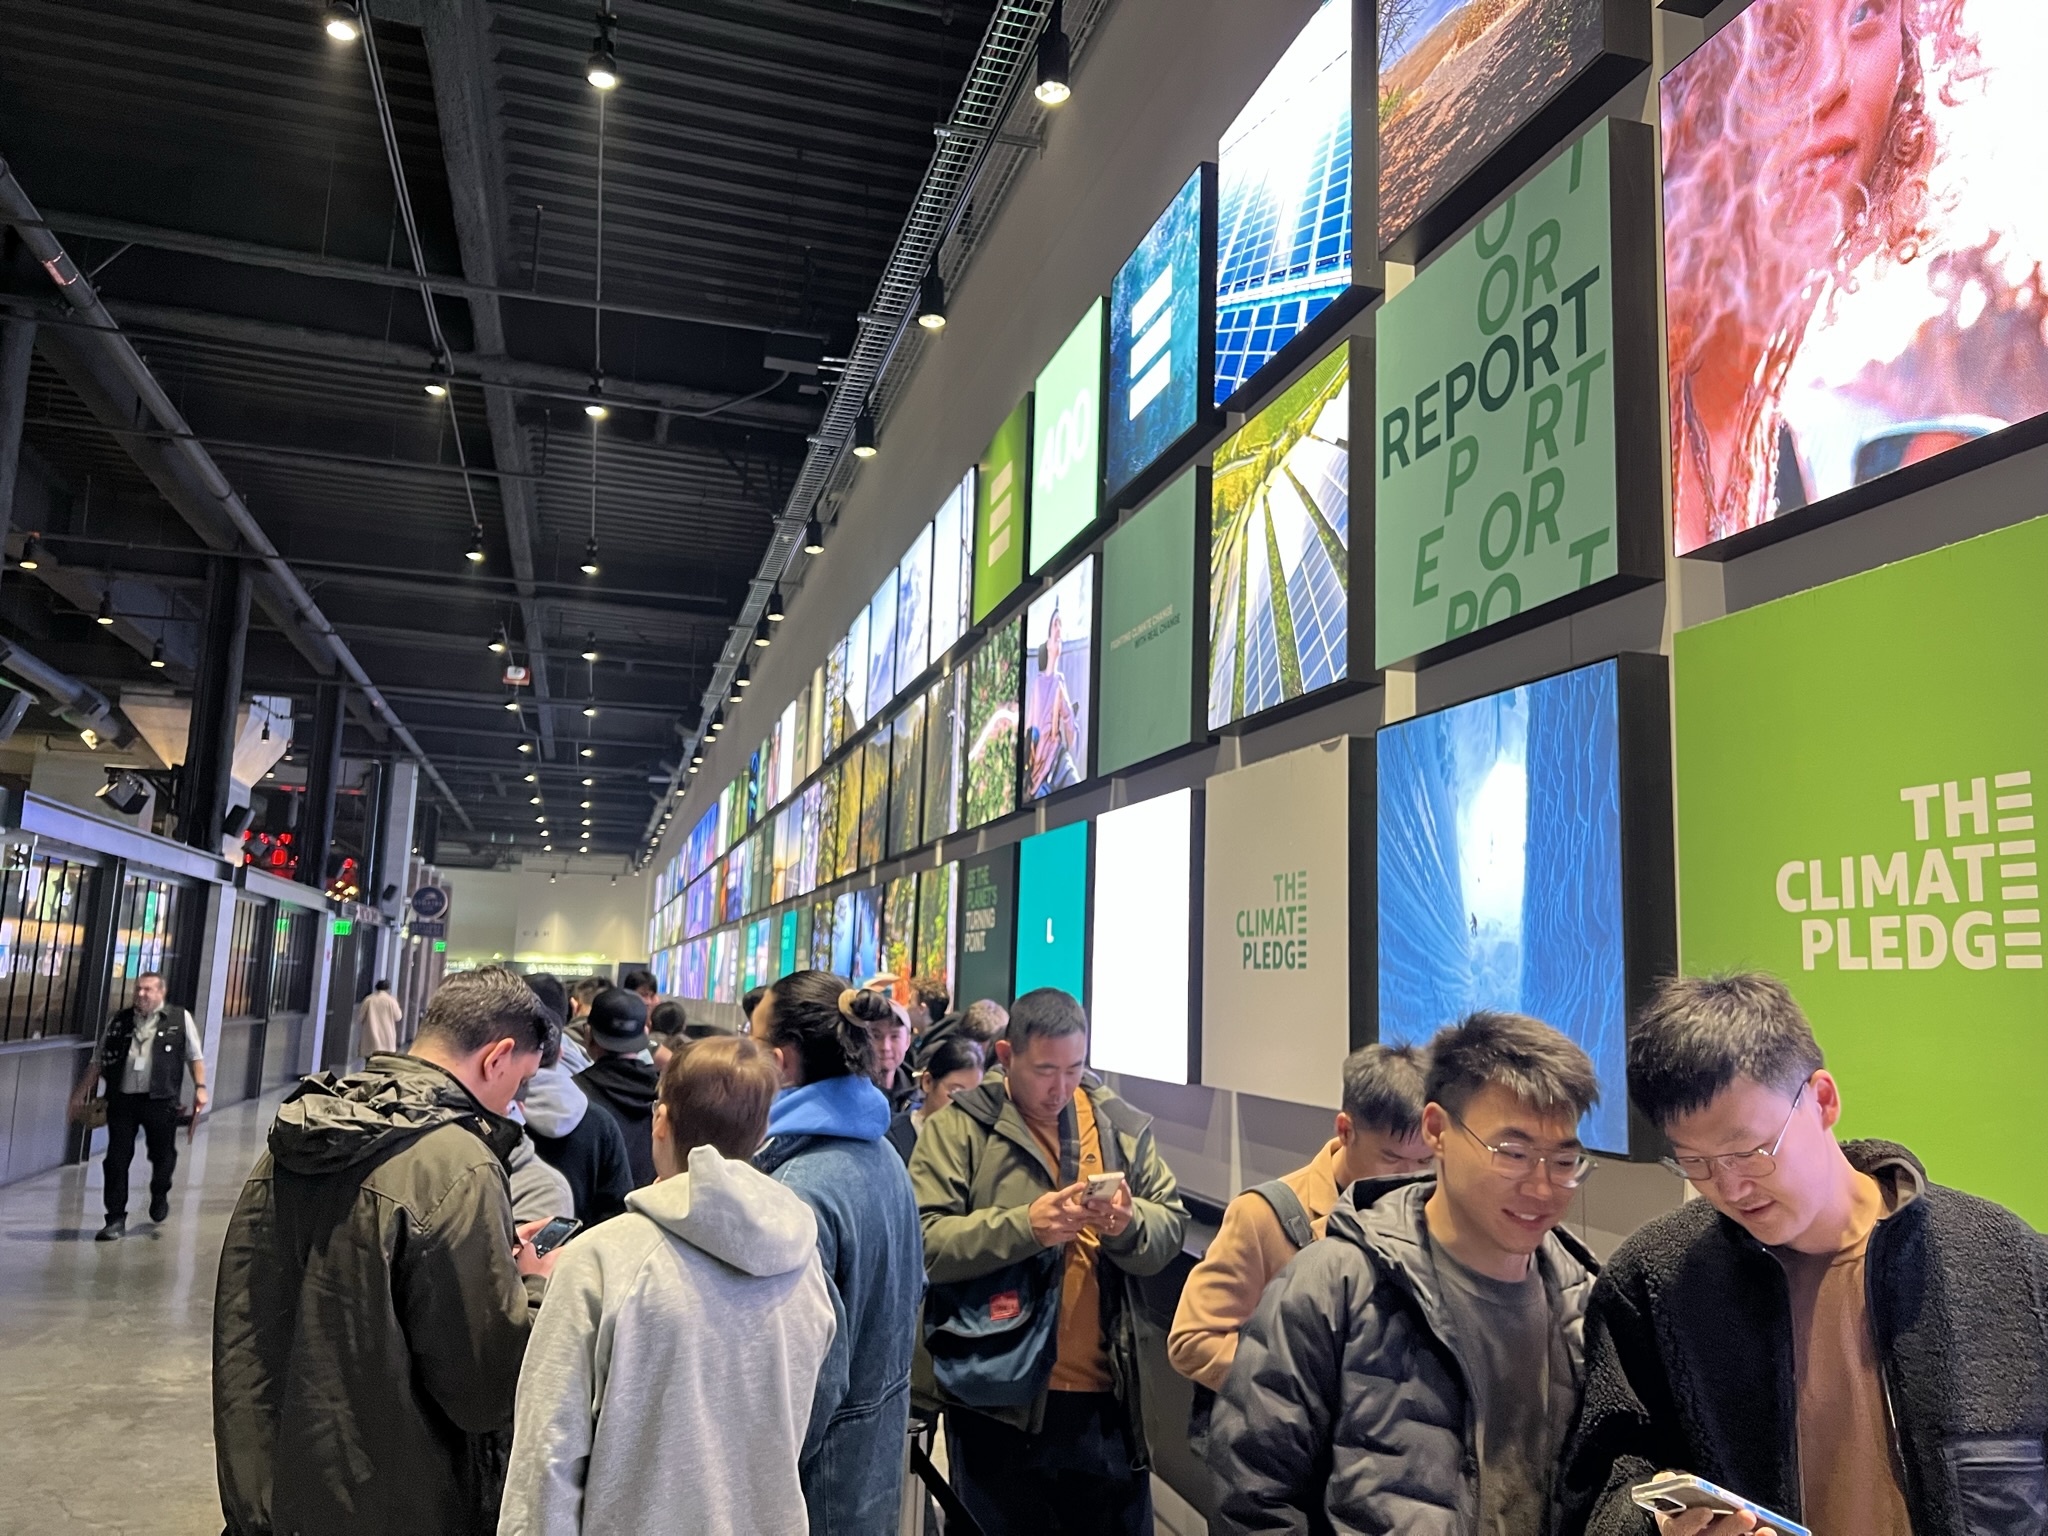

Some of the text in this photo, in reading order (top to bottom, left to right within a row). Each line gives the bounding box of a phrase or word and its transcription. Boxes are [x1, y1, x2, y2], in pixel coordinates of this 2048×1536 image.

[1383, 265, 1600, 479] REPORT
[1038, 388, 1091, 494] 400
[1900, 771, 2034, 841] THE
[1273, 870, 1307, 902] THE
[1775, 839, 2038, 913] CLIMATE
[965, 907, 995, 931] TURNING
[1236, 905, 1307, 938] CLIMATE
[1801, 909, 2043, 970] PLEDGE
[1243, 940, 1307, 970] PLEDGE
